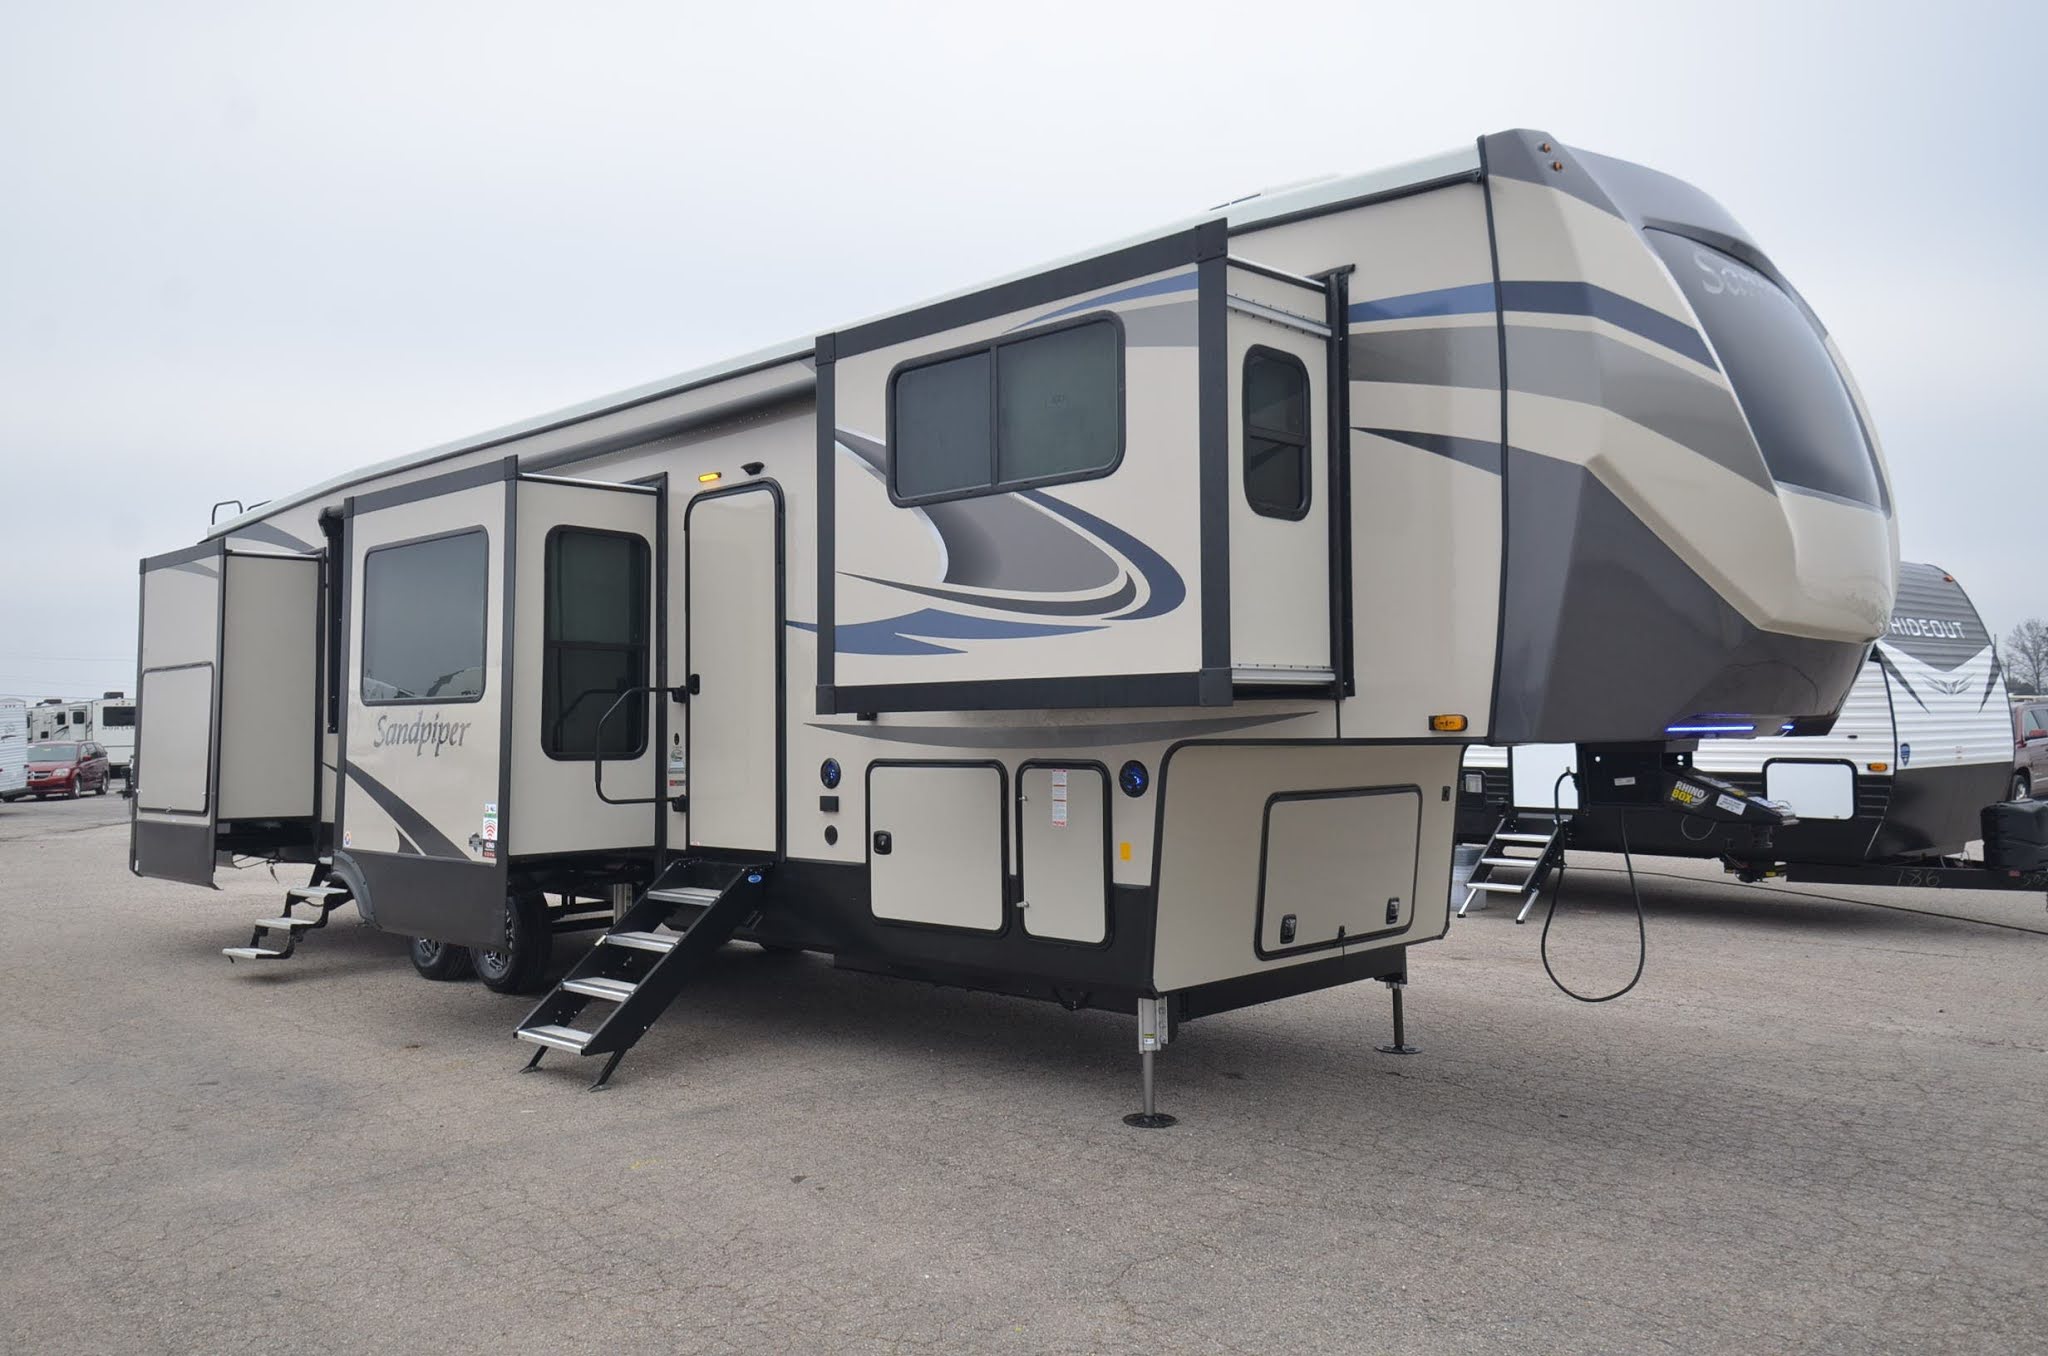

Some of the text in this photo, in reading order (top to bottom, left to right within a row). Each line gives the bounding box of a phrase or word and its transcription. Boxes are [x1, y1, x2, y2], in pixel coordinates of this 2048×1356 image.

[1890, 618, 1965, 638] HIDEOUT
[373, 711, 471, 757] Sandpiper
[1671, 788, 1693, 804] BOX
[1675, 780, 1705, 798] RHINO
